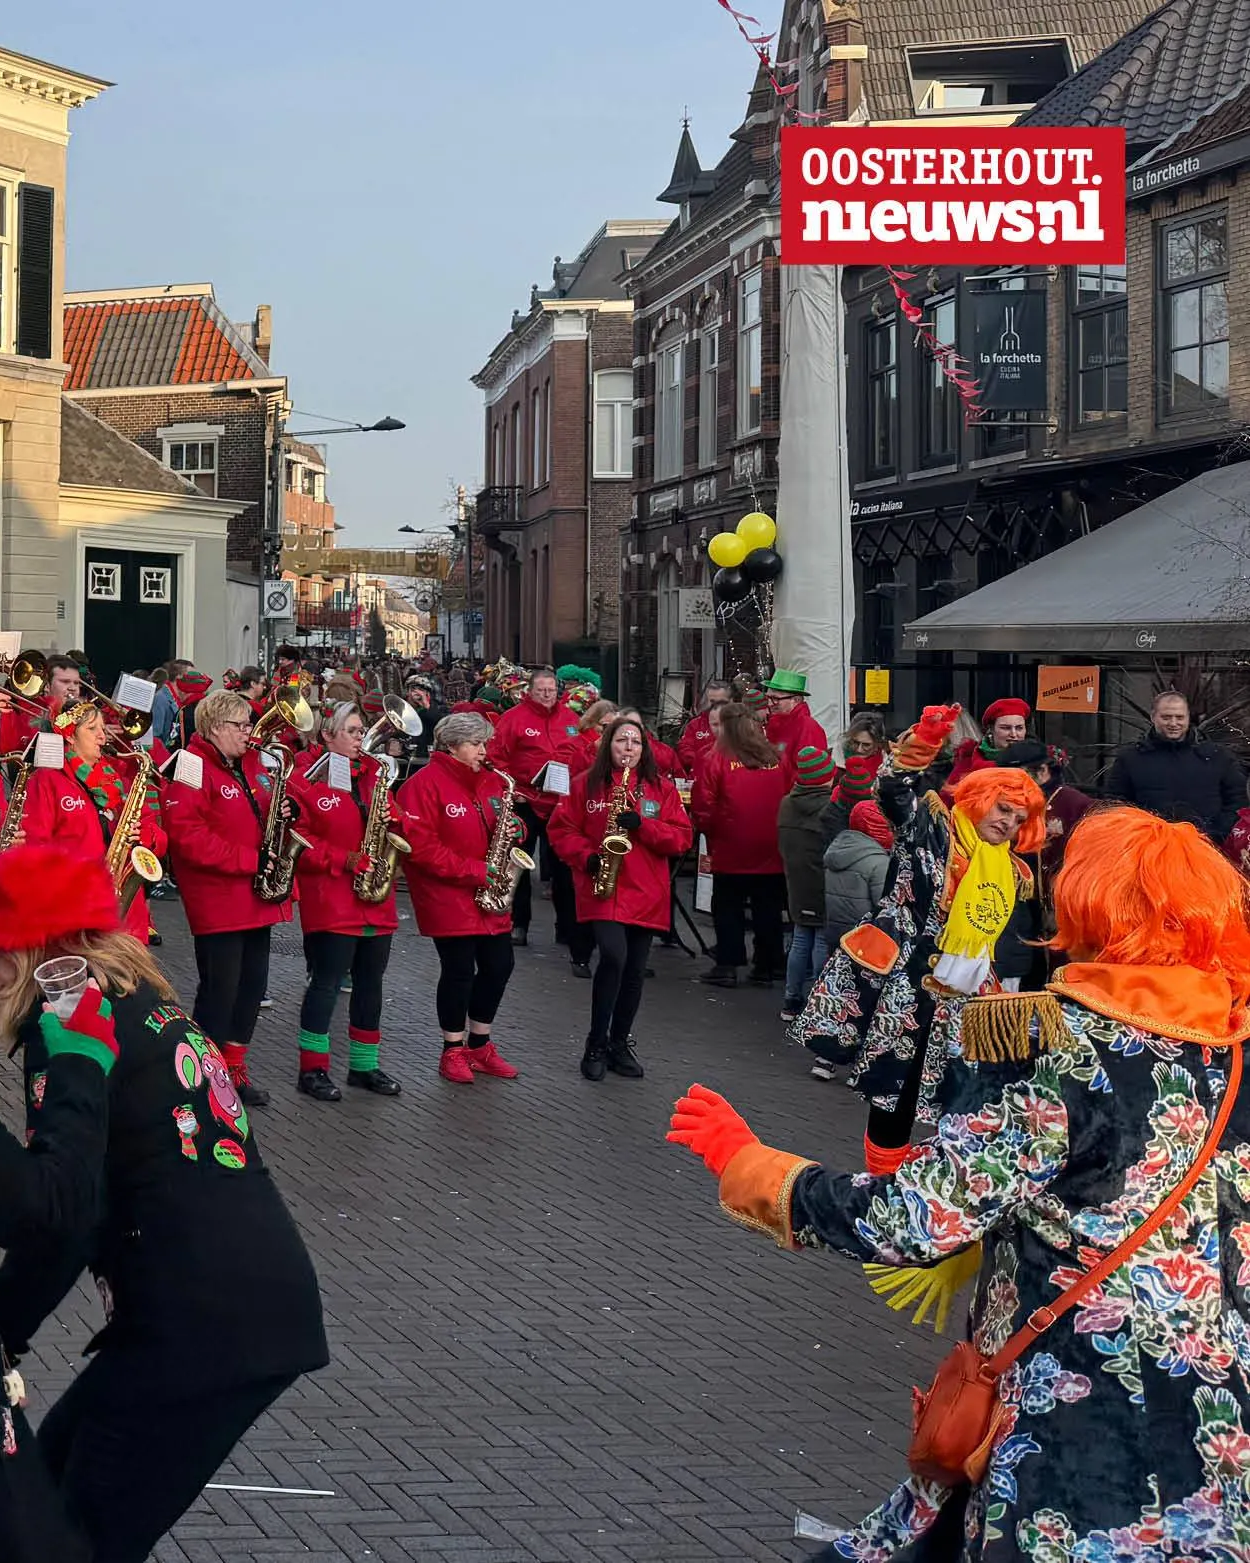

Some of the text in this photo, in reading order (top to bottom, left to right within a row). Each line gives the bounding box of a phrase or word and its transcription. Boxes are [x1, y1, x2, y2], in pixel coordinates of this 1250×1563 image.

[1132, 157, 1200, 191] la forchetta
[980, 352, 1041, 363] la forchetta
[861, 504, 879, 515] cucina
[880, 500, 903, 512] italiana
